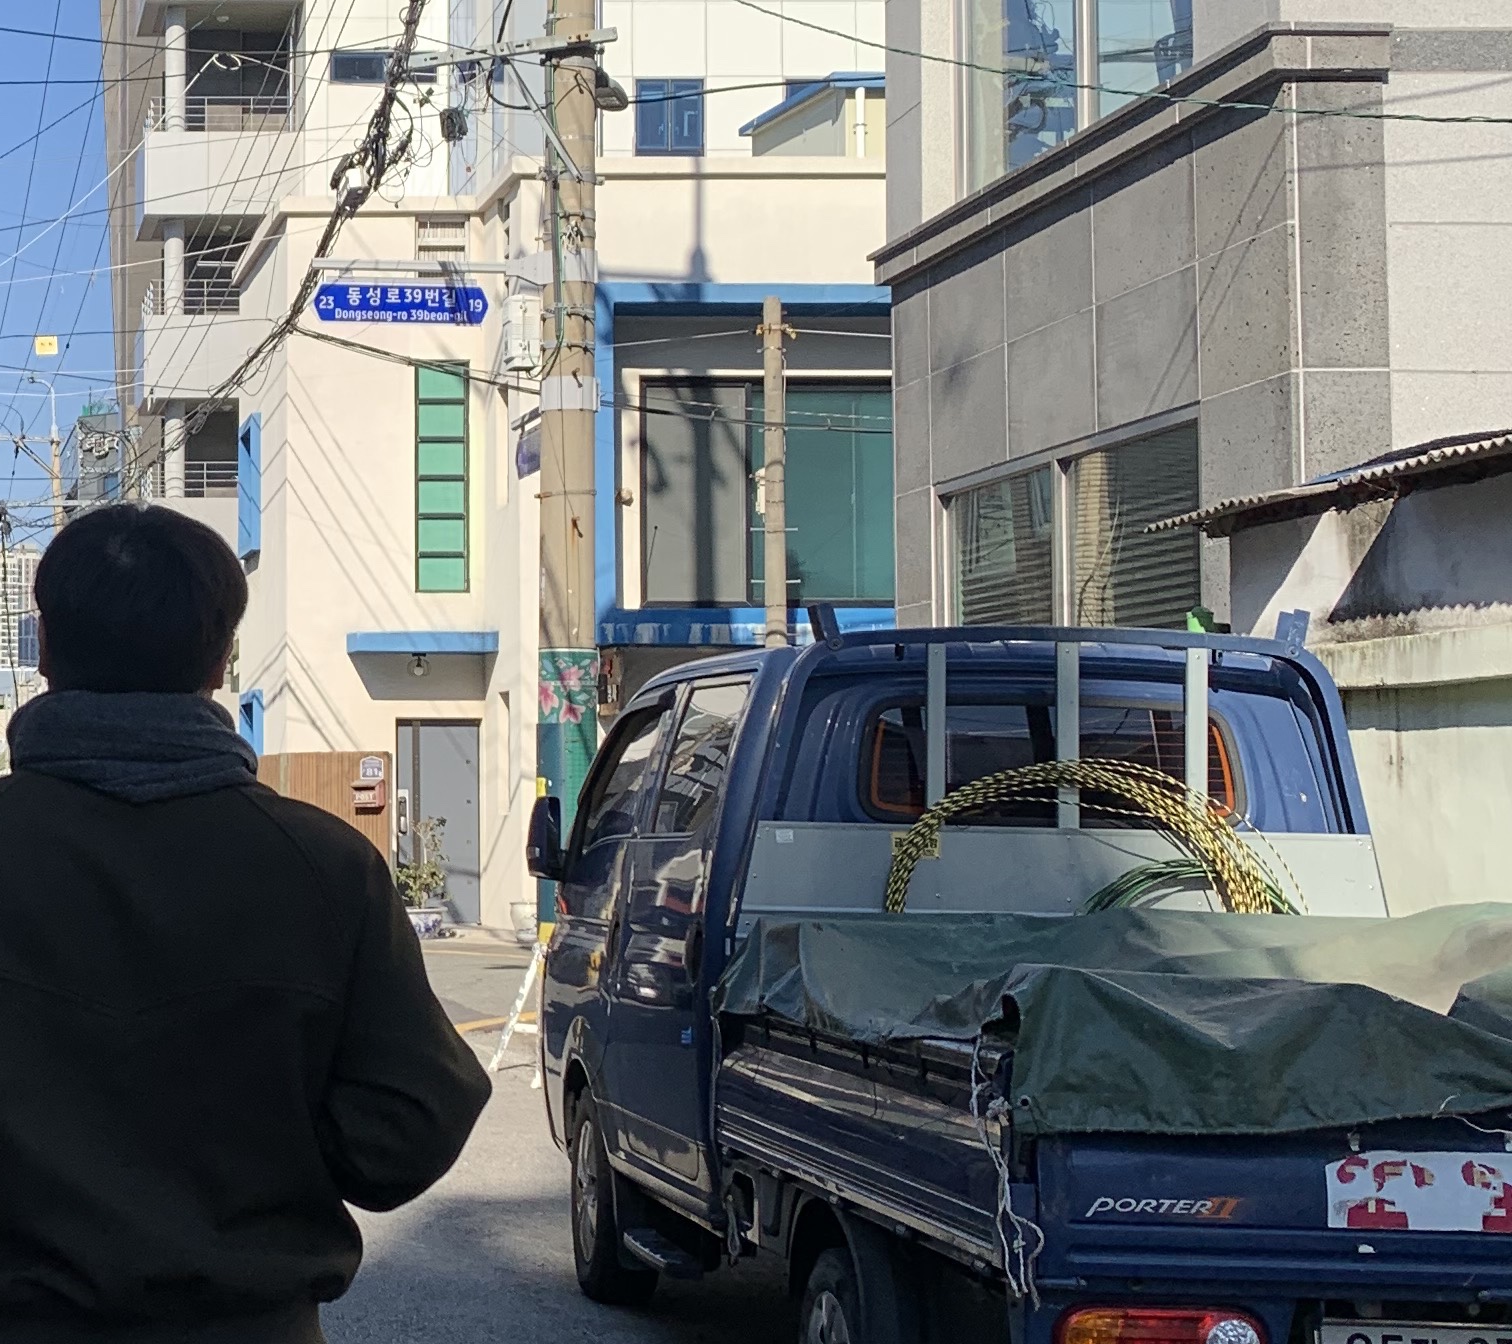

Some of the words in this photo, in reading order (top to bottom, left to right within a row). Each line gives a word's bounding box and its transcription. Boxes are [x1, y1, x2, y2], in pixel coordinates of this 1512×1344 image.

[319, 296, 335, 309] 23
[346, 287, 457, 308] 동성로39번길
[468, 298, 483, 312] 19
[335, 308, 407, 322] Dongseong-ro
[1084, 1197, 1214, 1218] PORTER
